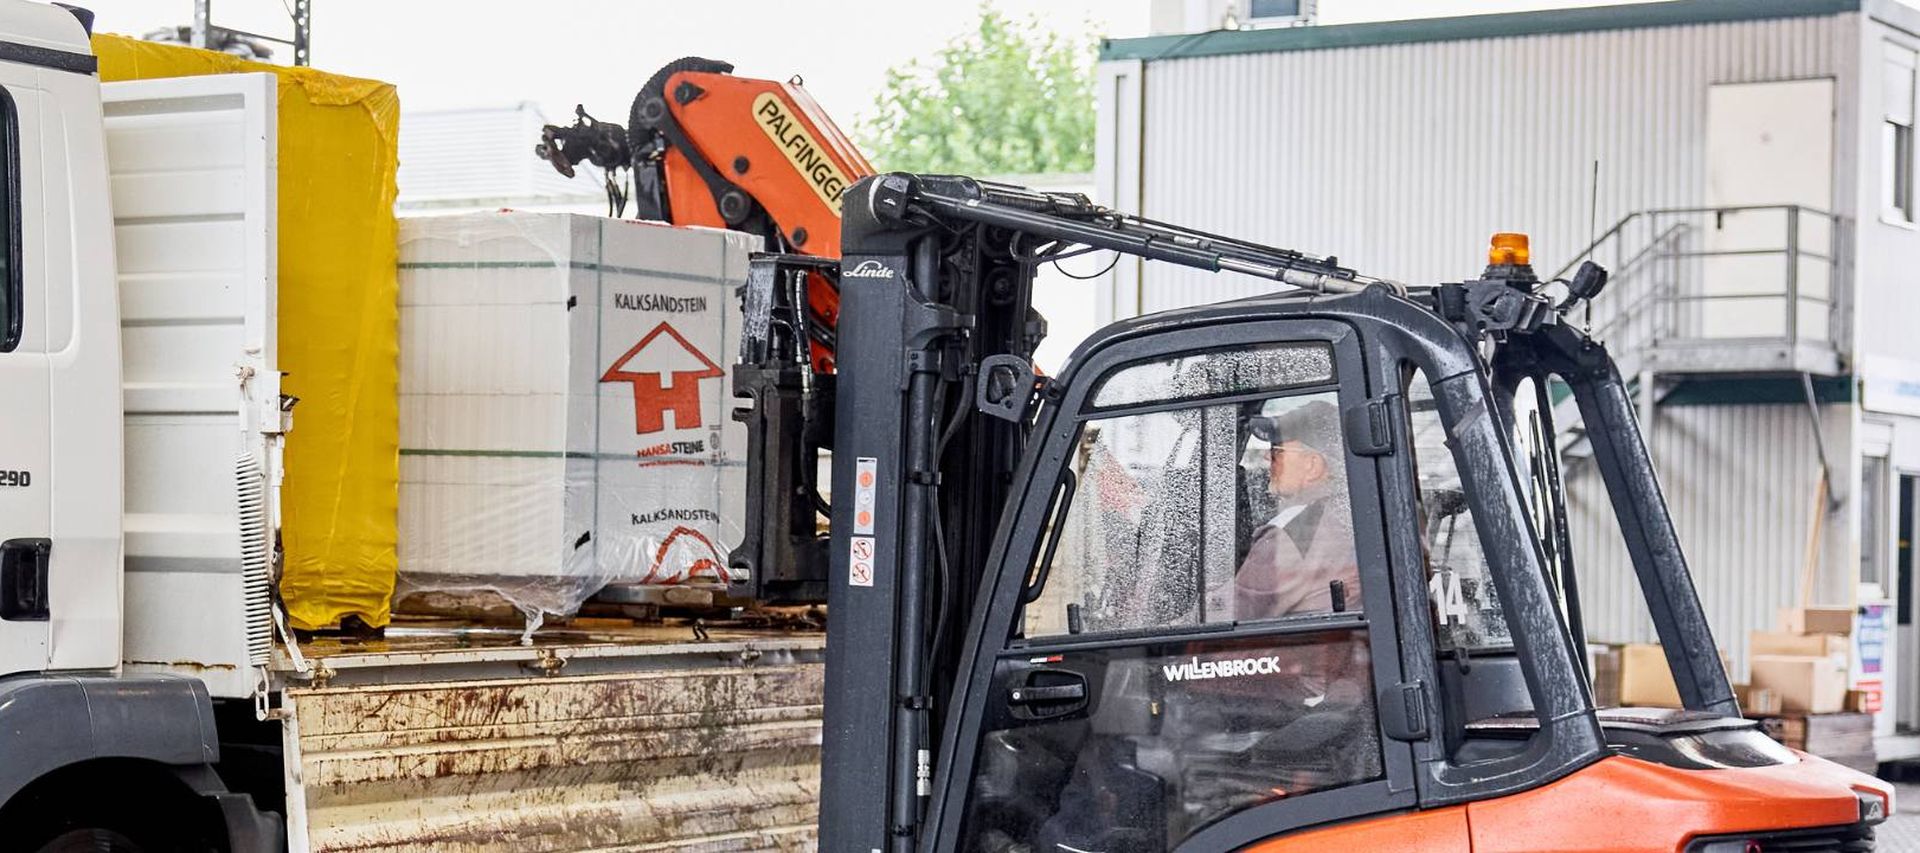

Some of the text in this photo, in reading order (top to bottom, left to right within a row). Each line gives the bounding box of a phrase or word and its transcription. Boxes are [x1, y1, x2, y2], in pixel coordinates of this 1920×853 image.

[843, 260, 894, 279] Linde
[615, 293, 707, 313] KALKSANDSTEIN
[637, 440, 704, 458] HANSASTEINE
[632, 508, 720, 525] KALKSANDSTEIN
[1429, 573, 1468, 625] 14
[1163, 656, 1281, 682] WILLENBROCK
